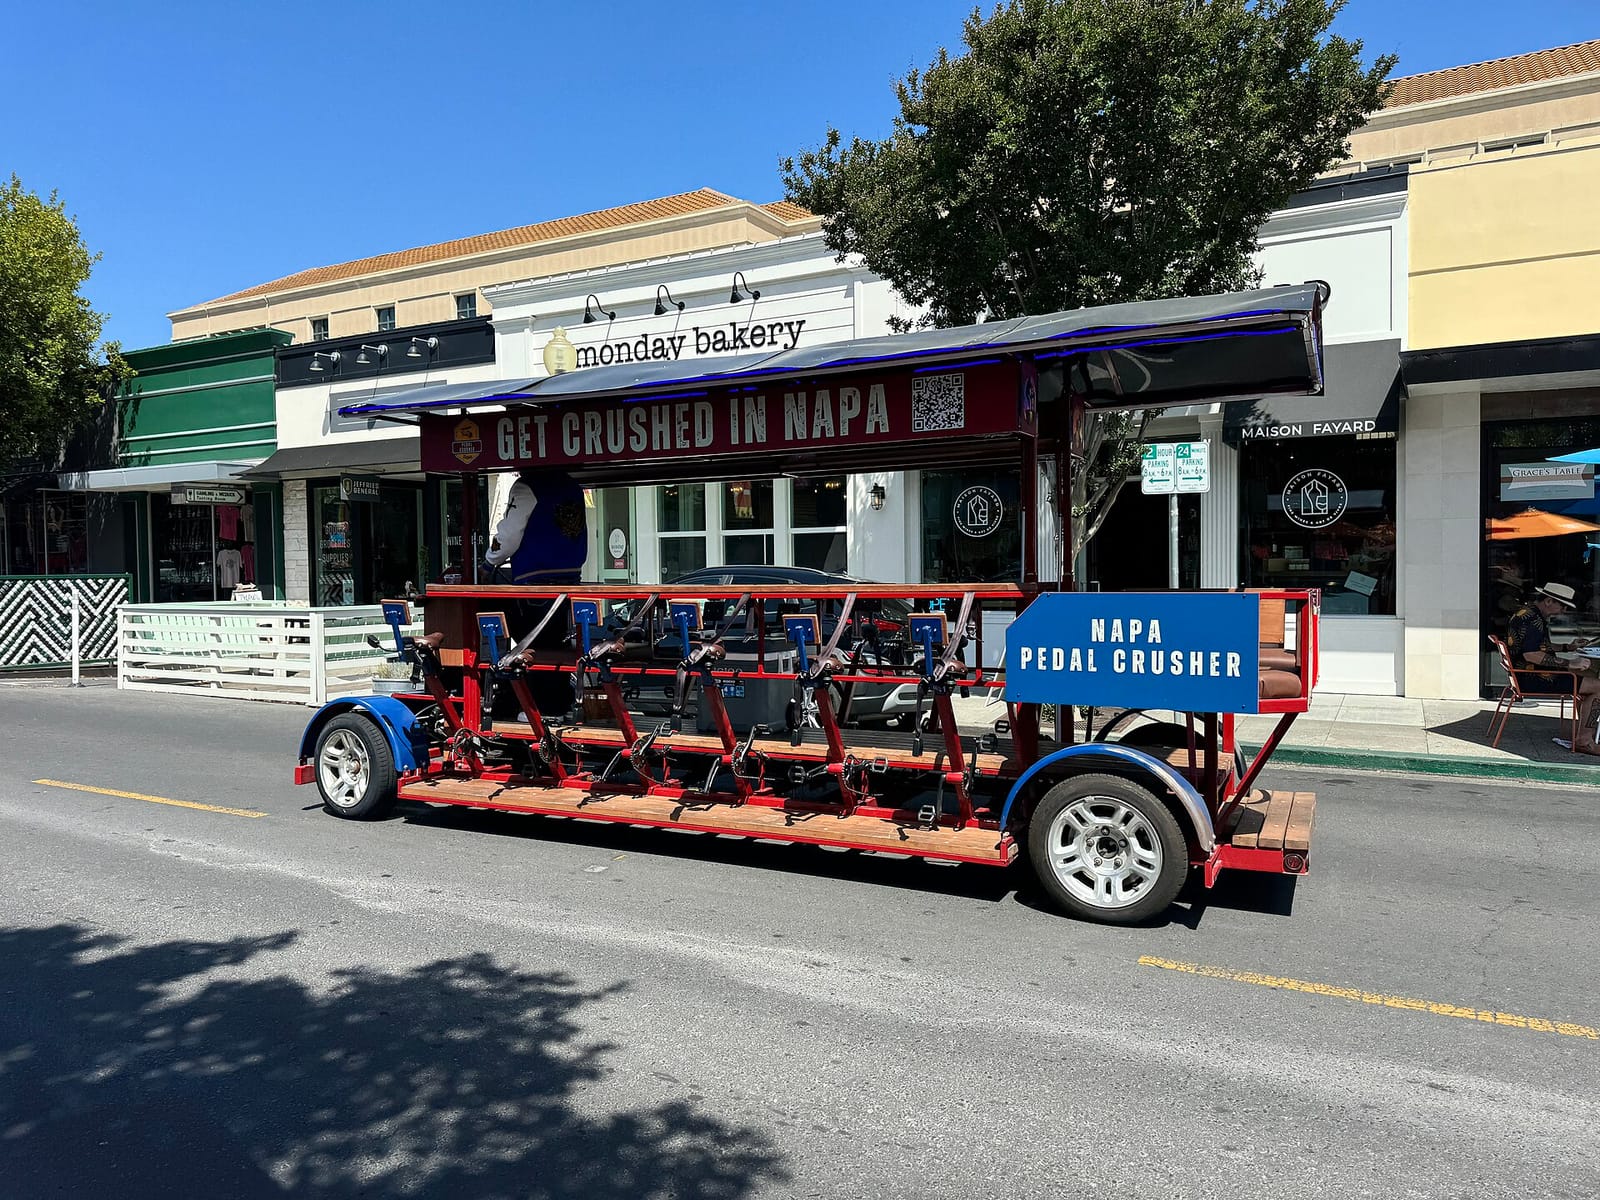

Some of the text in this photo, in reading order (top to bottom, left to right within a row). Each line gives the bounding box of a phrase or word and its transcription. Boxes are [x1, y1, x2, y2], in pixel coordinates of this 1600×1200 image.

[576, 319, 806, 369] monday bakery
[497, 383, 890, 461] GET CRUSHED IN NAPA
[1242, 420, 1376, 439] MAISON FAYARD
[1157, 448, 1173, 457] HOUR
[1177, 446, 1189, 457] 24
[1148, 460, 1169, 468] PARKING
[1182, 458, 1204, 466] PARKING
[1513, 467, 1582, 477] GRACE'S TABLE
[1287, 471, 1344, 496] MAISON FAYARD
[1091, 618, 1162, 643] NAPA
[1020, 646, 1241, 677] PEDAL CRUSHER
